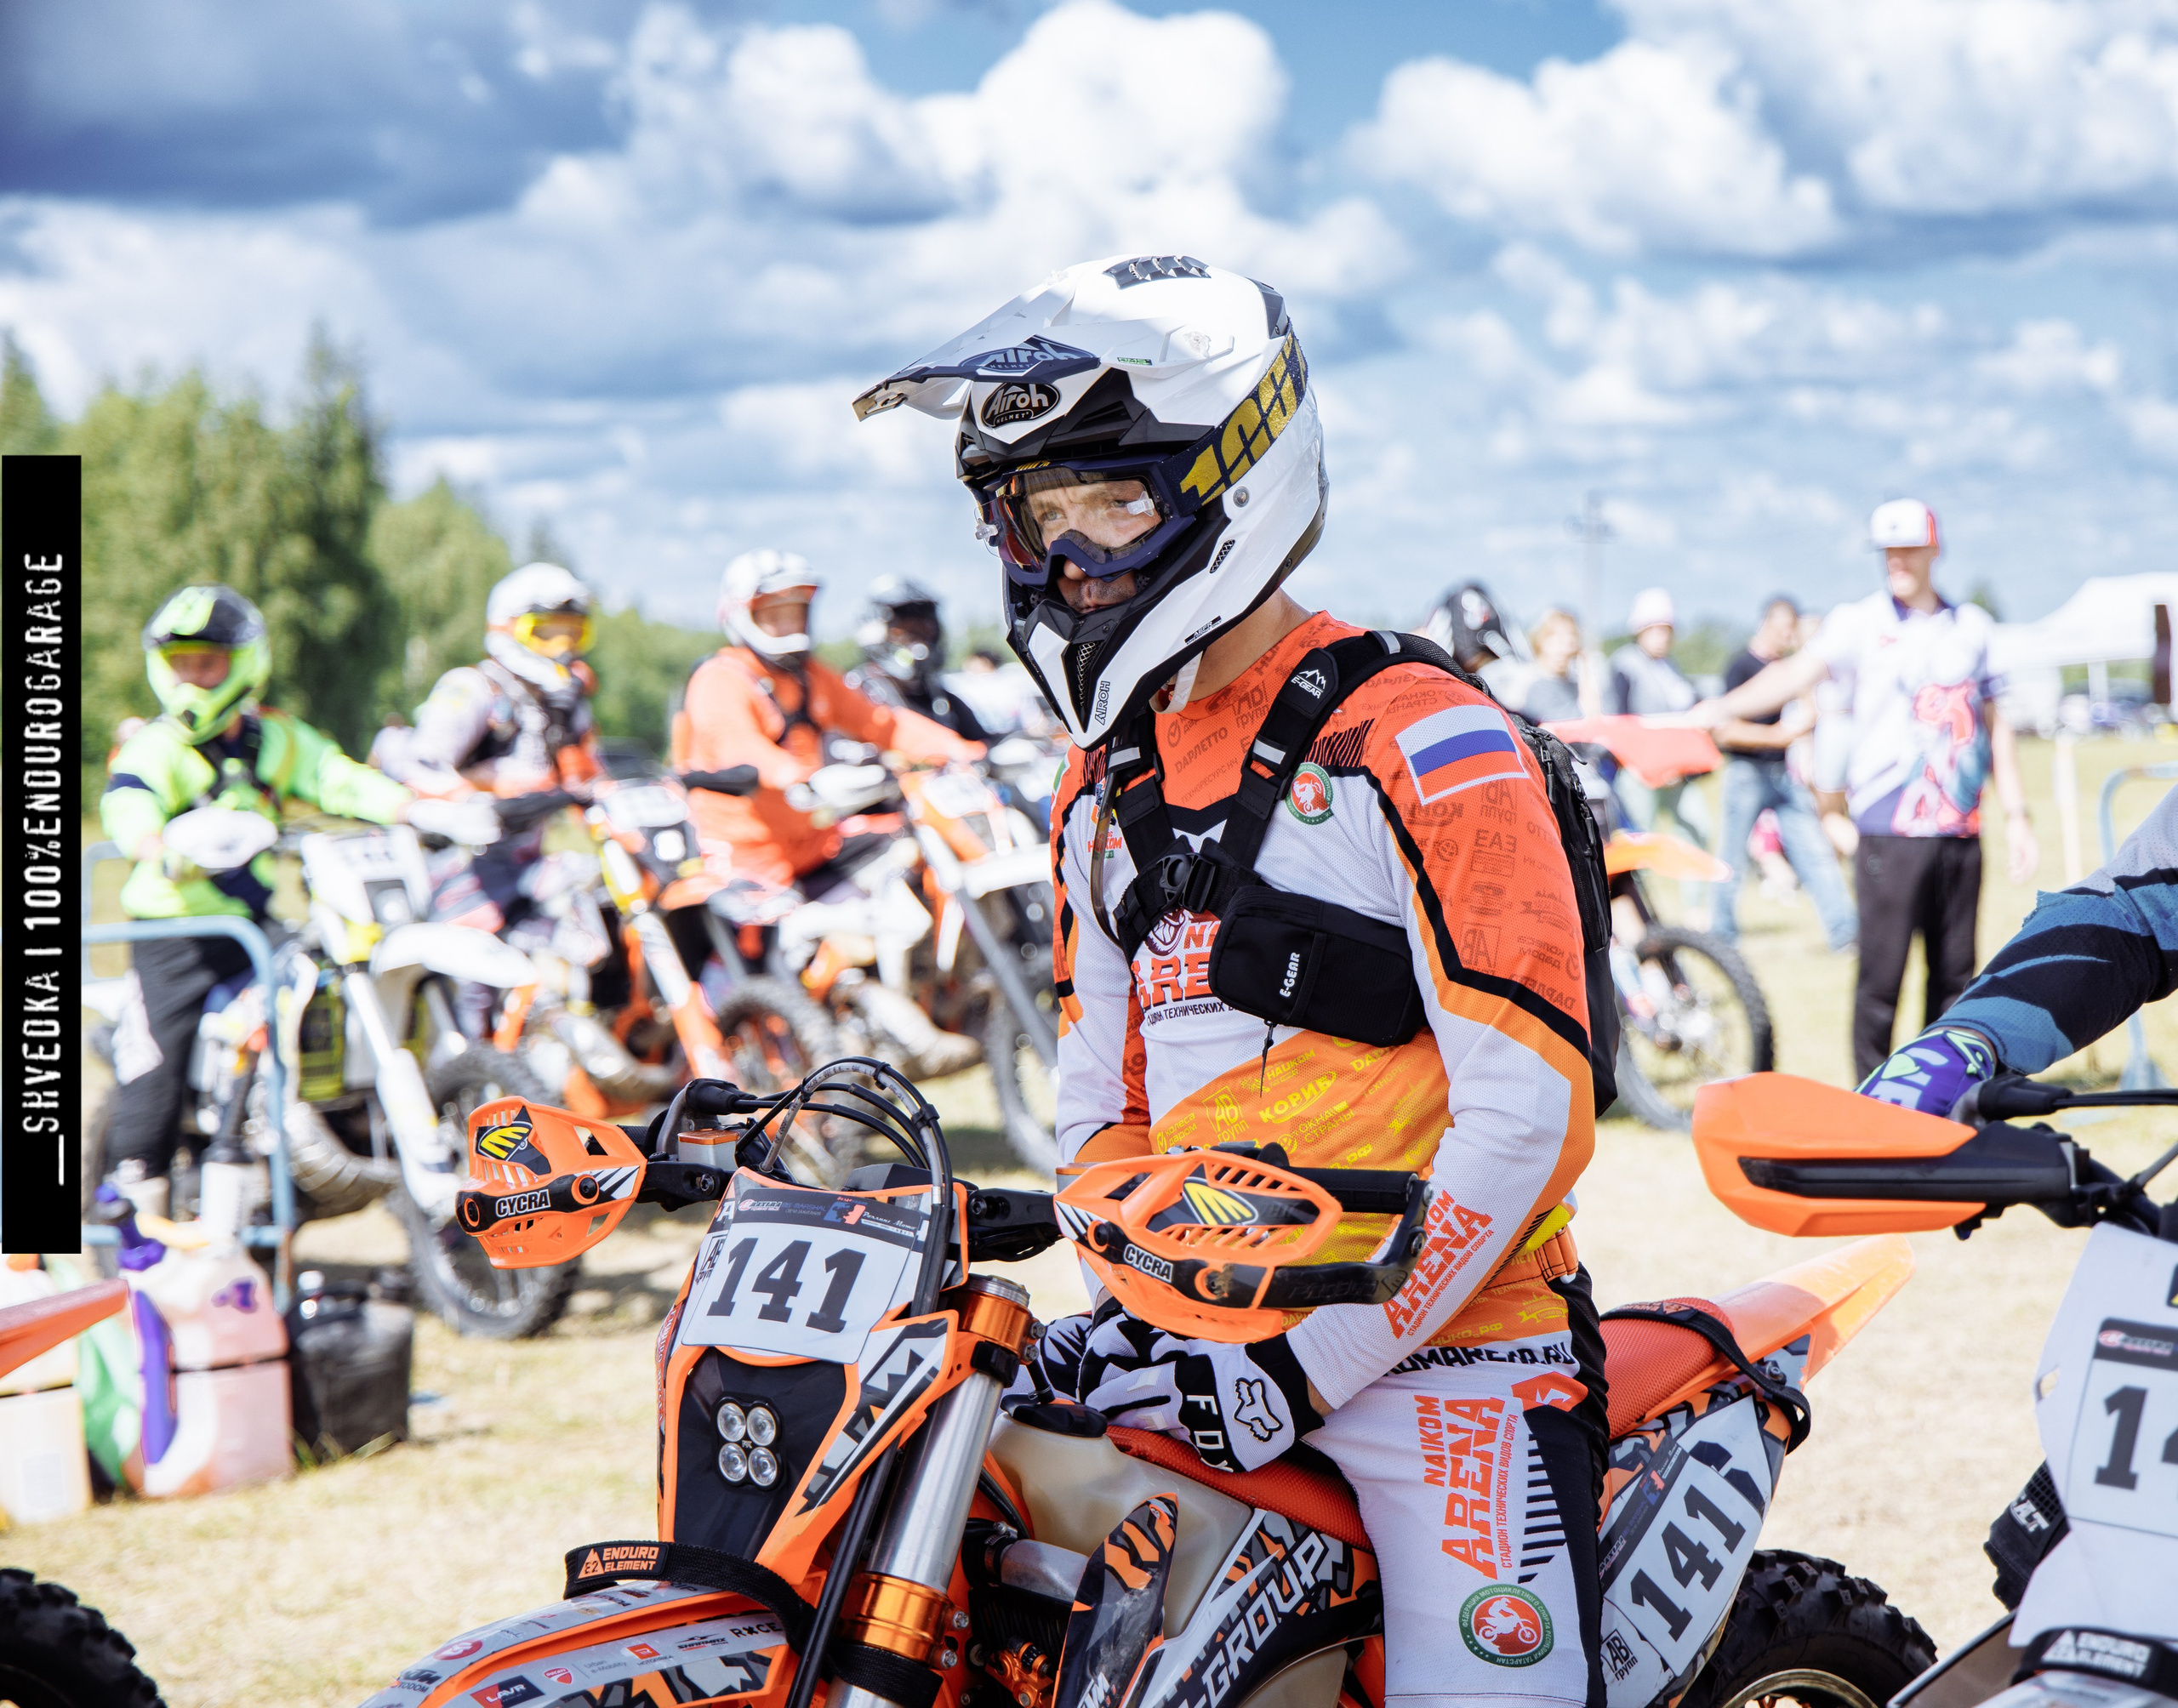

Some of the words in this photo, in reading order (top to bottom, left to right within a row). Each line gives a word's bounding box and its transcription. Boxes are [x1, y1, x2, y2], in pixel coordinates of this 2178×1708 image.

[983, 342, 1079, 365] Airoh
[985, 384, 1049, 419] Airoh
[996, 412, 1030, 424] HELMET
[1291, 676, 1321, 698] E-GEAR
[1095, 680, 1111, 726] AIROH
[1280, 952, 1300, 997] E-GEAR
[1163, 1002, 1225, 1019] ТЕХНИЧЕСКИХ
[1166, 1113, 1195, 1136] колеса
[1214, 1094, 1239, 1132] АВ
[1217, 1119, 1250, 1142] групп
[496, 1189, 551, 1218] CYCRA
[1123, 1244, 1173, 1284] CYCRA
[1382, 1204, 1493, 1339] ARENA
[706, 1238, 866, 1333] 141
[1414, 1395, 1445, 1487] NAIKOM
[1503, 1413, 1519, 1441] СПОРТА
[1498, 1440, 1513, 1468] ВИДОВ
[1441, 1397, 1505, 1580] ARENA
[1496, 1469, 1509, 1527] ТЕХНИЧЕСКИХ
[602, 1546, 659, 1561] ENDURO
[1497, 1528, 1513, 1569] СТАДИОН
[604, 1560, 657, 1573] ELEMENT
[1631, 1484, 1746, 1643] 141
[1480, 1586, 1540, 1606] МОТОЦИКЛЕТНОГО
[1462, 1595, 1480, 1628] ФЕДЕРАЦИЯ
[1497, 1655, 1534, 1665] ТАТАРСТАН
[1607, 1632, 1631, 1671] АВ
[546, 1668, 567, 1677] DUCATI
[1614, 1655, 1639, 1681] групп
[485, 1682, 526, 1703] LAVR
